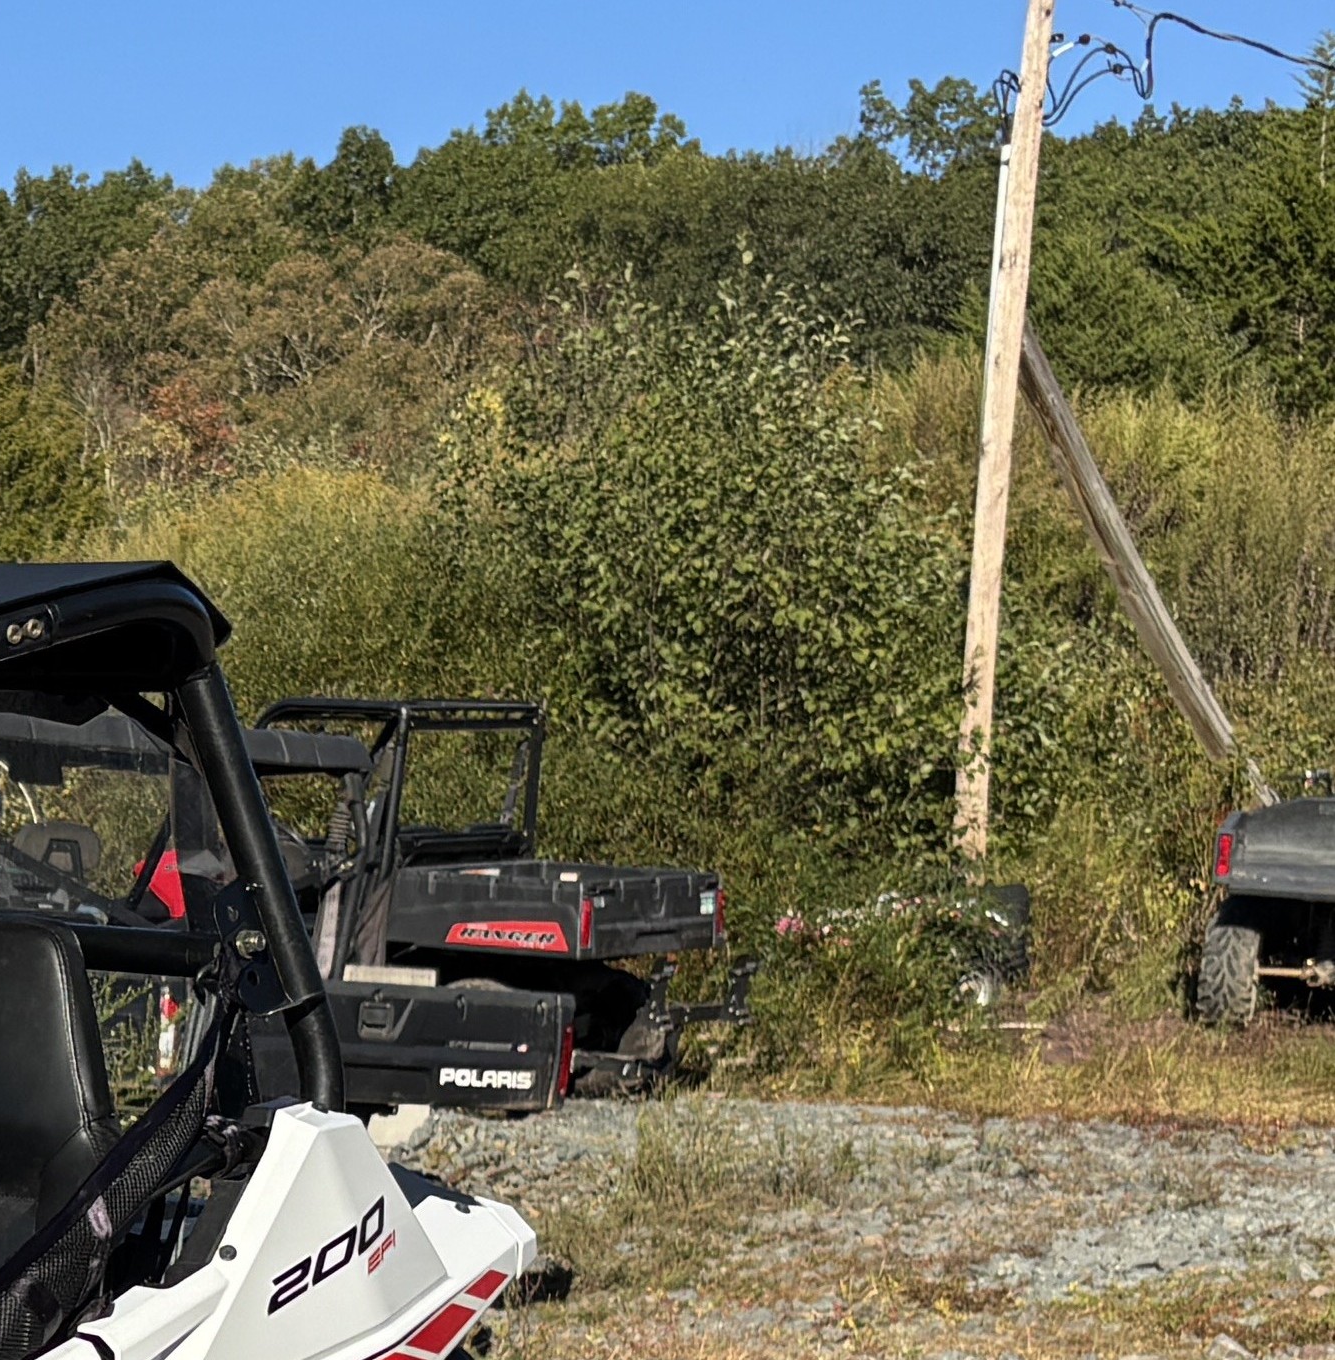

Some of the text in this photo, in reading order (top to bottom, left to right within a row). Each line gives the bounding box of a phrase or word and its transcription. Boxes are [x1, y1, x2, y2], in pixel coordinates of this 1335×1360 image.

[459, 927, 557, 944] RANGER
[439, 1067, 533, 1090] POLARIS
[267, 1195, 385, 1316] 200
[367, 1229, 396, 1276] EFI
